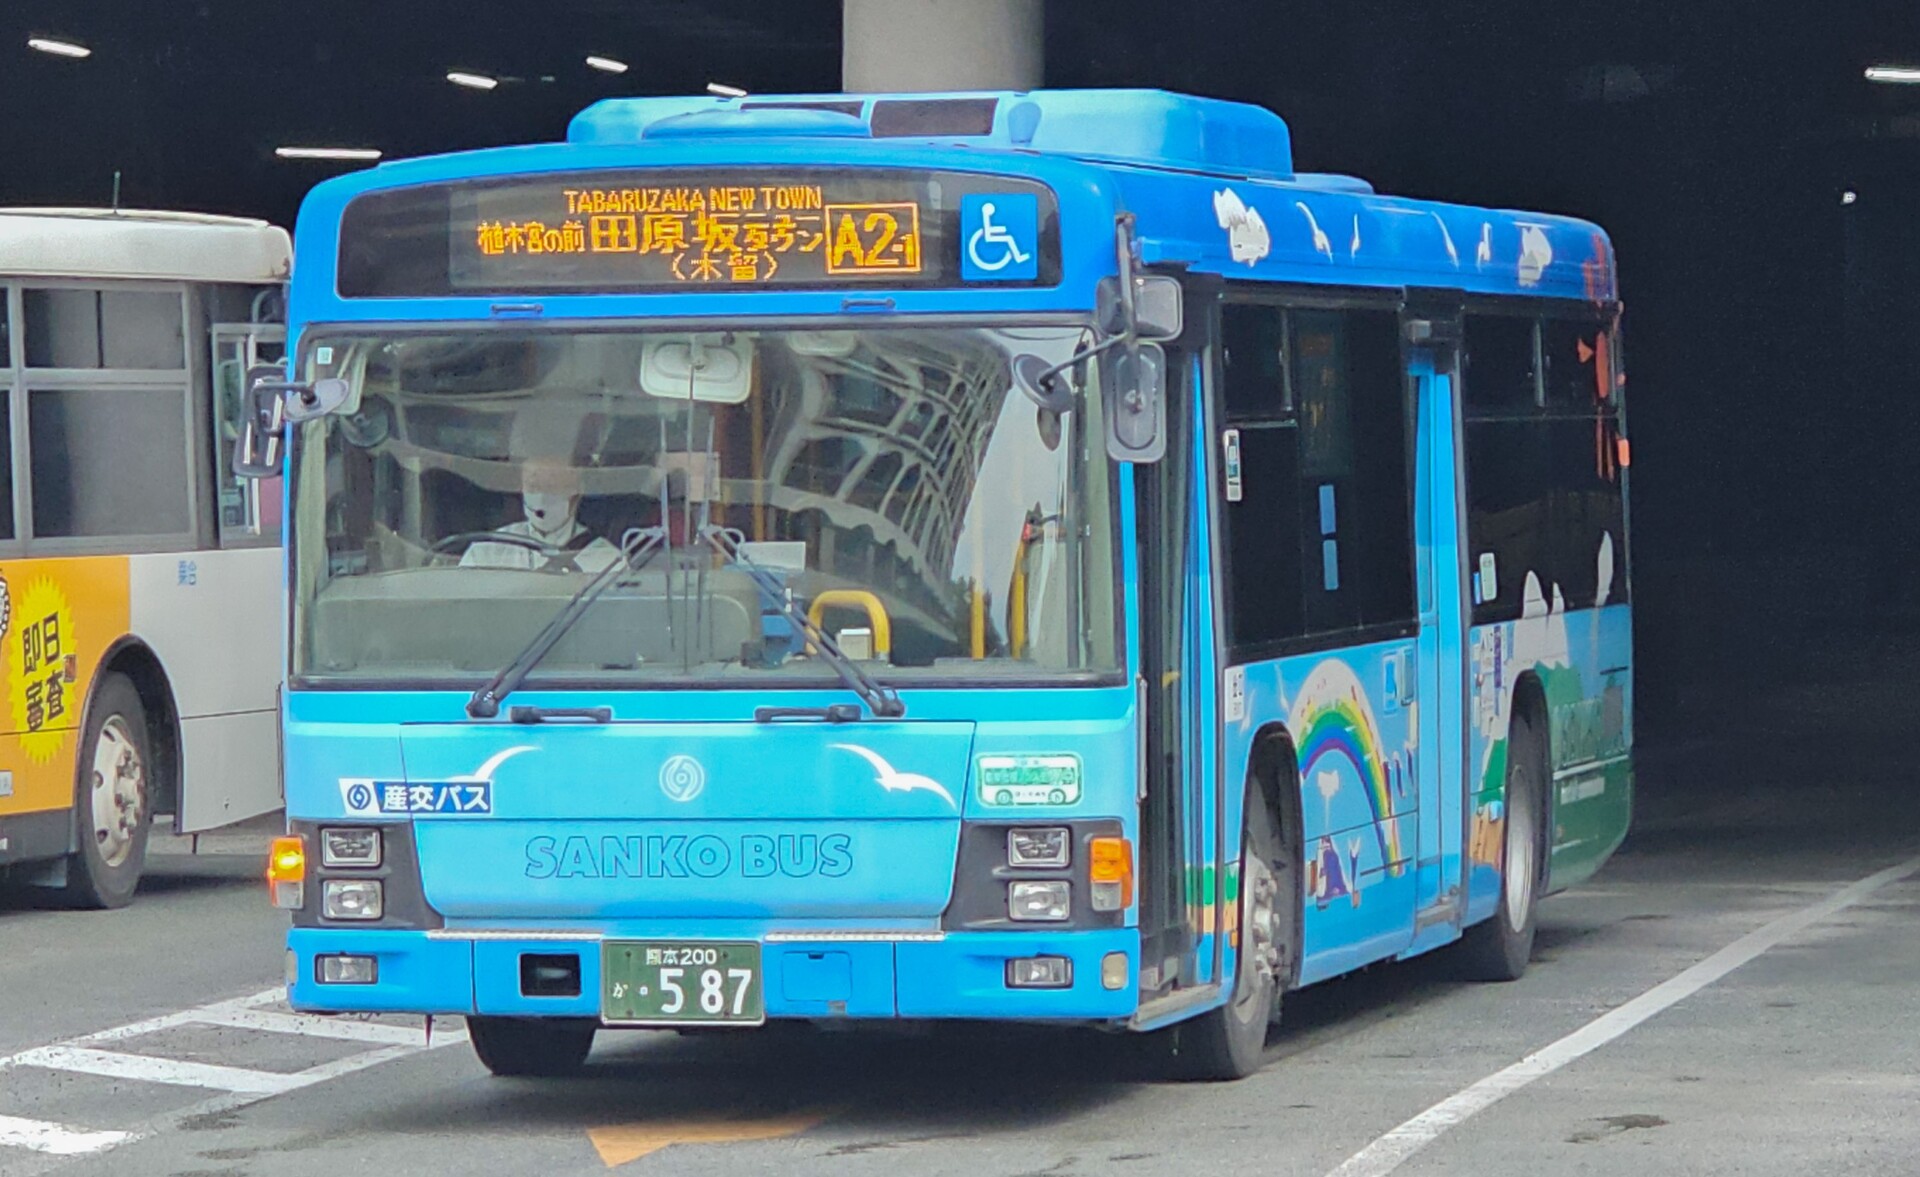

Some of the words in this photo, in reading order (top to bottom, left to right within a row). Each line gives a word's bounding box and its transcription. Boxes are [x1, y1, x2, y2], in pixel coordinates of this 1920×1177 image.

[563, 188, 705, 214] TABARUZAKA
[709, 187, 756, 211] NEW
[760, 186, 822, 210] TOWN
[833, 212, 914, 266] A2-1
[22, 612, 60, 676] 即日
[384, 785, 489, 811] 産交バス
[525, 835, 731, 879] SANKO
[741, 834, 853, 878] BUS
